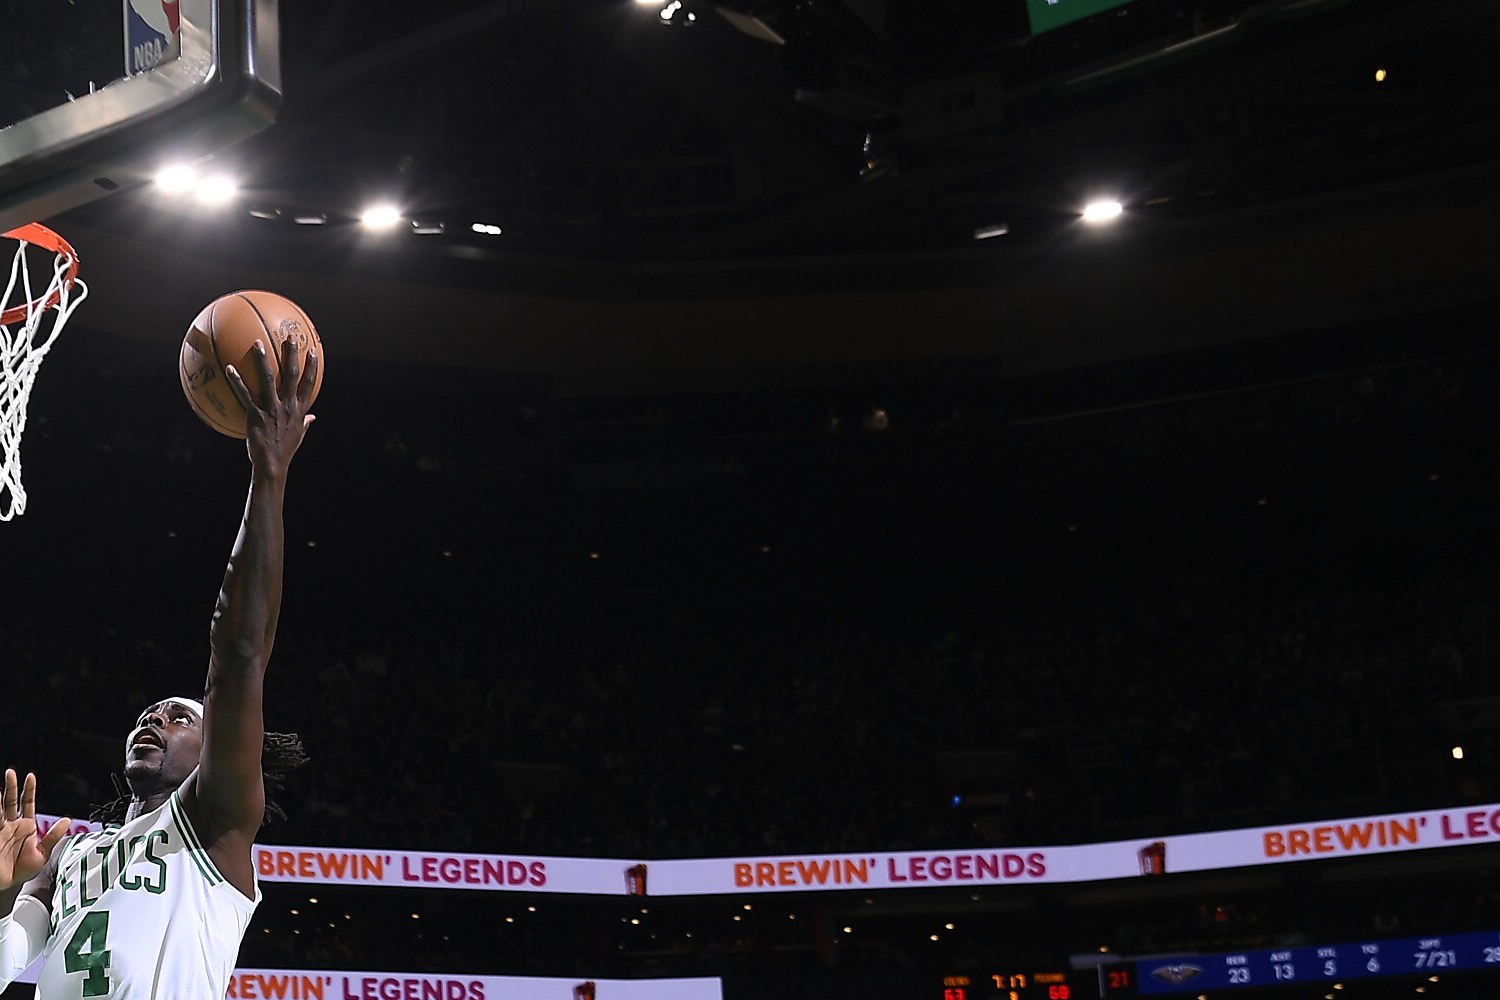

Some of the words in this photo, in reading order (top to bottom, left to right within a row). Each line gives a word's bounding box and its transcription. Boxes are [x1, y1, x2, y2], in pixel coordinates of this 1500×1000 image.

[134, 38, 162, 71] NBA
[1264, 819, 1426, 857] BREWIN'
[258, 850, 391, 880] BREWIN'
[402, 857, 546, 886] LEGENDS
[734, 859, 876, 887] BREWIN'
[888, 853, 1046, 882] LEGENDS
[64, 910, 111, 997] 4
[1228, 966, 1250, 983] 23
[1273, 962, 1295, 979] 13
[1324, 959, 1337, 976] 5
[1366, 957, 1380, 972] 6
[1414, 949, 1456, 968] 7/21
